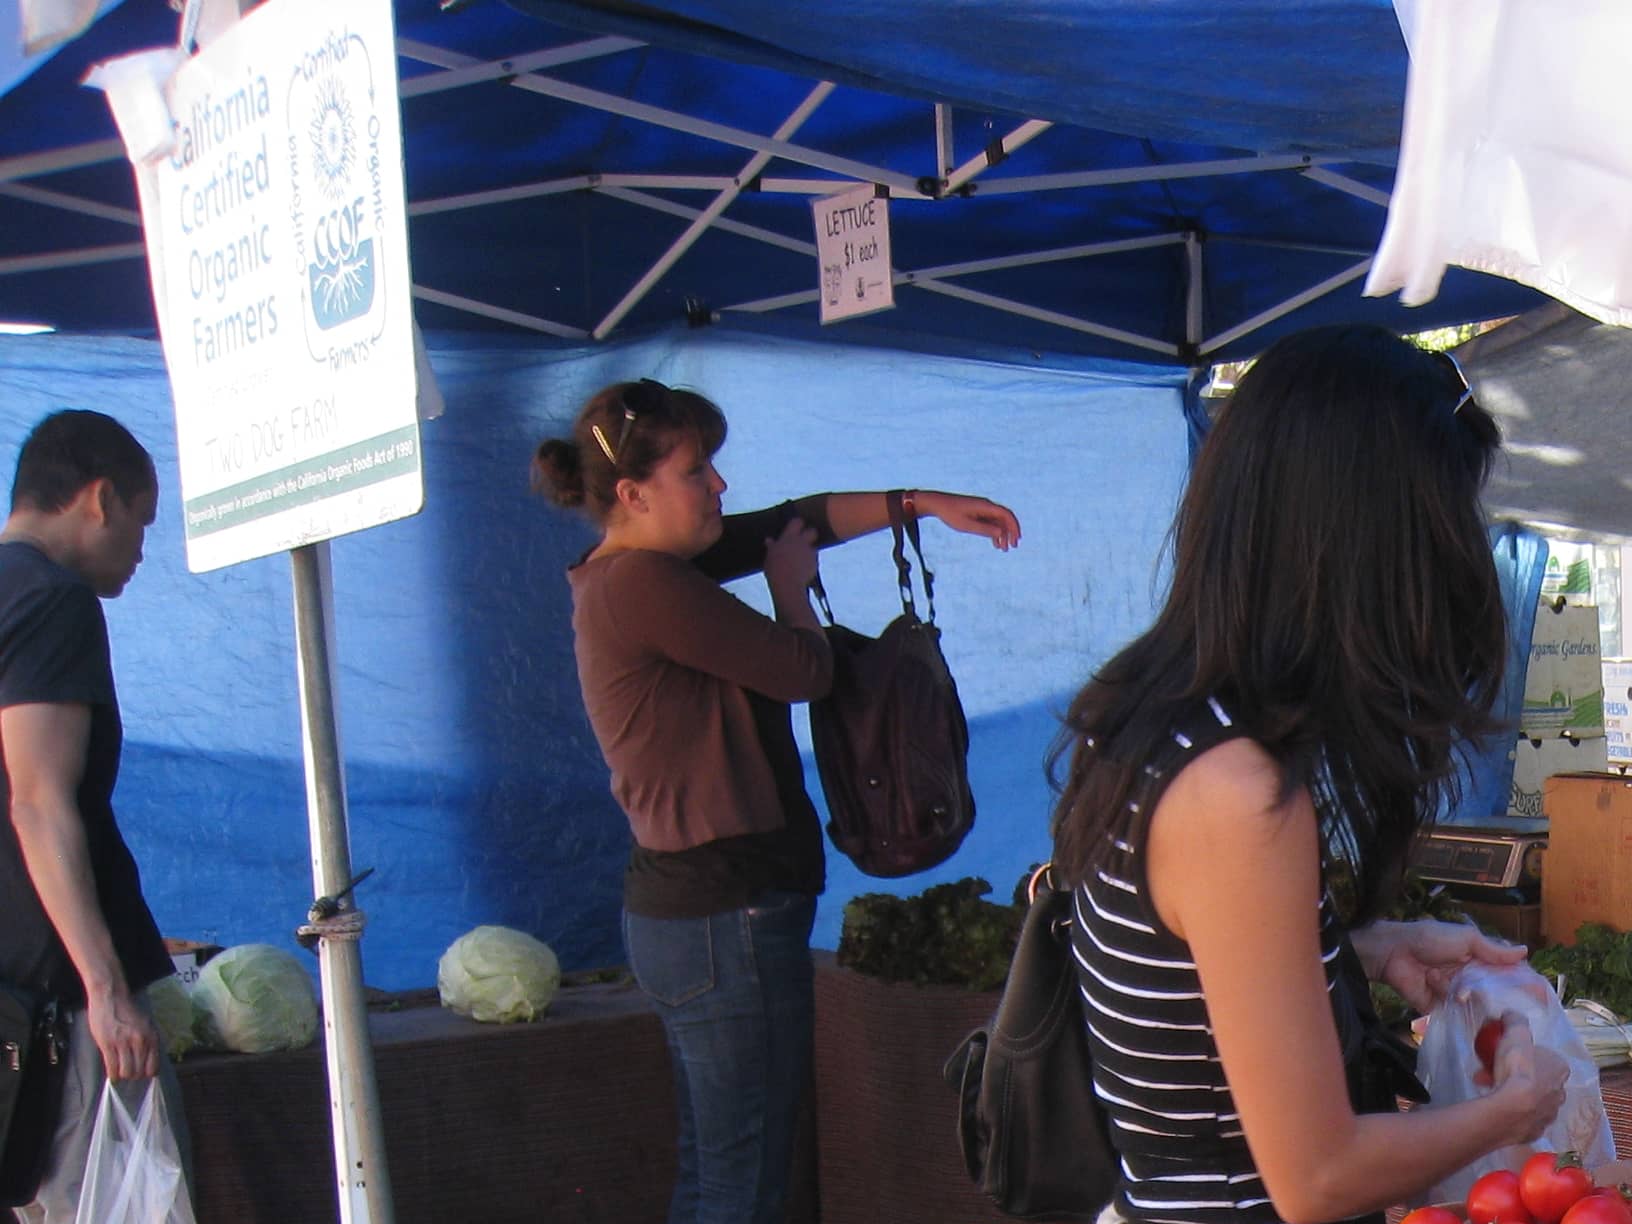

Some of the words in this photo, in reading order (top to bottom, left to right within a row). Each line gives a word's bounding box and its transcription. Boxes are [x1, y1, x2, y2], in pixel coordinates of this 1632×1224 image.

[179, 131, 270, 235] Certified
[287, 131, 306, 276] California
[367, 114, 386, 233] Organic
[314, 195, 365, 270] CCOF
[825, 200, 875, 237] LETTUCE
[844, 240, 855, 271] $1
[859, 235, 878, 263] each
[189, 214, 272, 303] Organic
[193, 294, 279, 369] Farmers
[204, 432, 244, 473] TWO
[250, 415, 285, 463] DOG
[291, 392, 338, 450] FARM
[374, 448, 387, 466] Act
[1531, 639, 1559, 662] rganic
